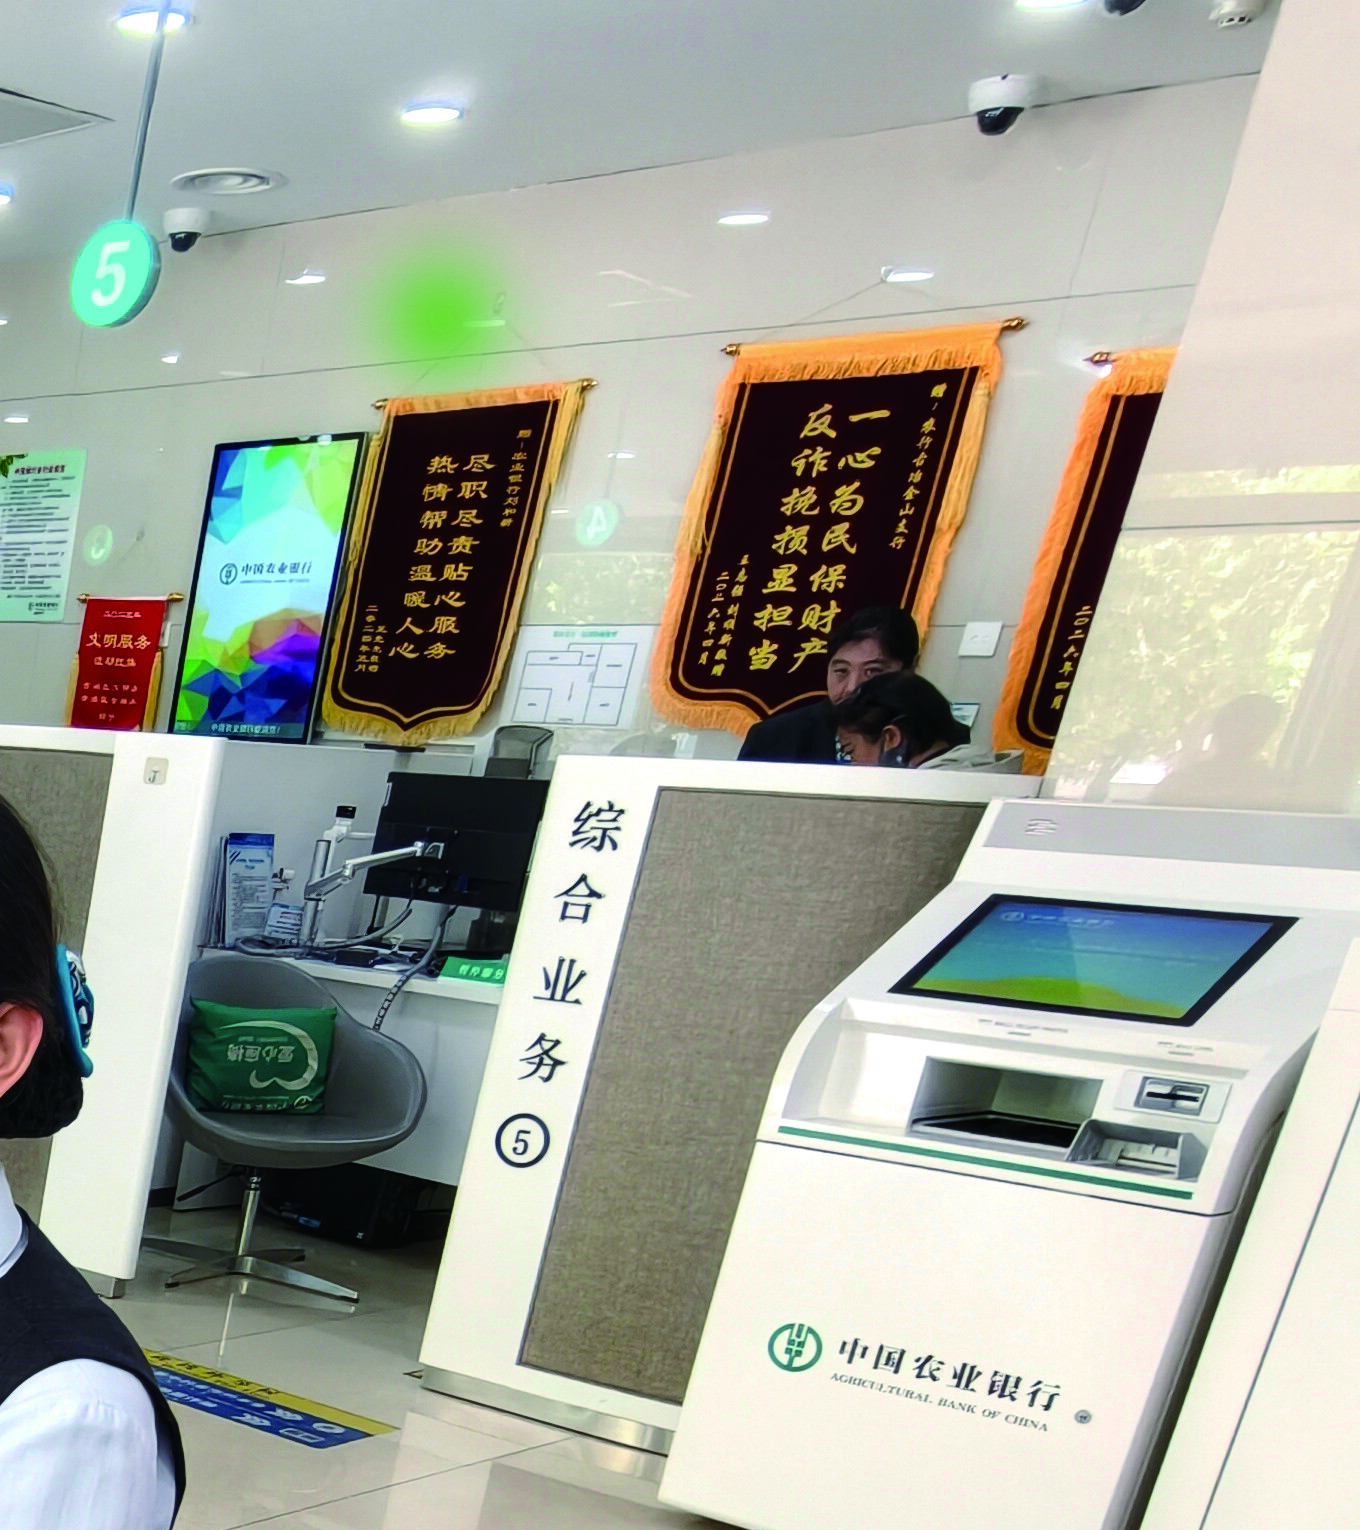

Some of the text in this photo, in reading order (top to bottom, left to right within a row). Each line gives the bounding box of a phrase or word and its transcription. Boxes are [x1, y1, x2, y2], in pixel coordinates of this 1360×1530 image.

[91, 240, 130, 307] 5
[388, 455, 459, 659] 热情帮助温暖人心
[423, 453, 496, 659] 尽职尽责贴心服务
[749, 403, 837, 671] 反诈挽损显担当
[787, 408, 891, 674] 一心为民保财产
[85, 631, 151, 649] 文明服务
[830, 1372, 1049, 1433] AGRICULTURAL BANK OF CHINA
[838, 1337, 1061, 1412] 中国农业银行
